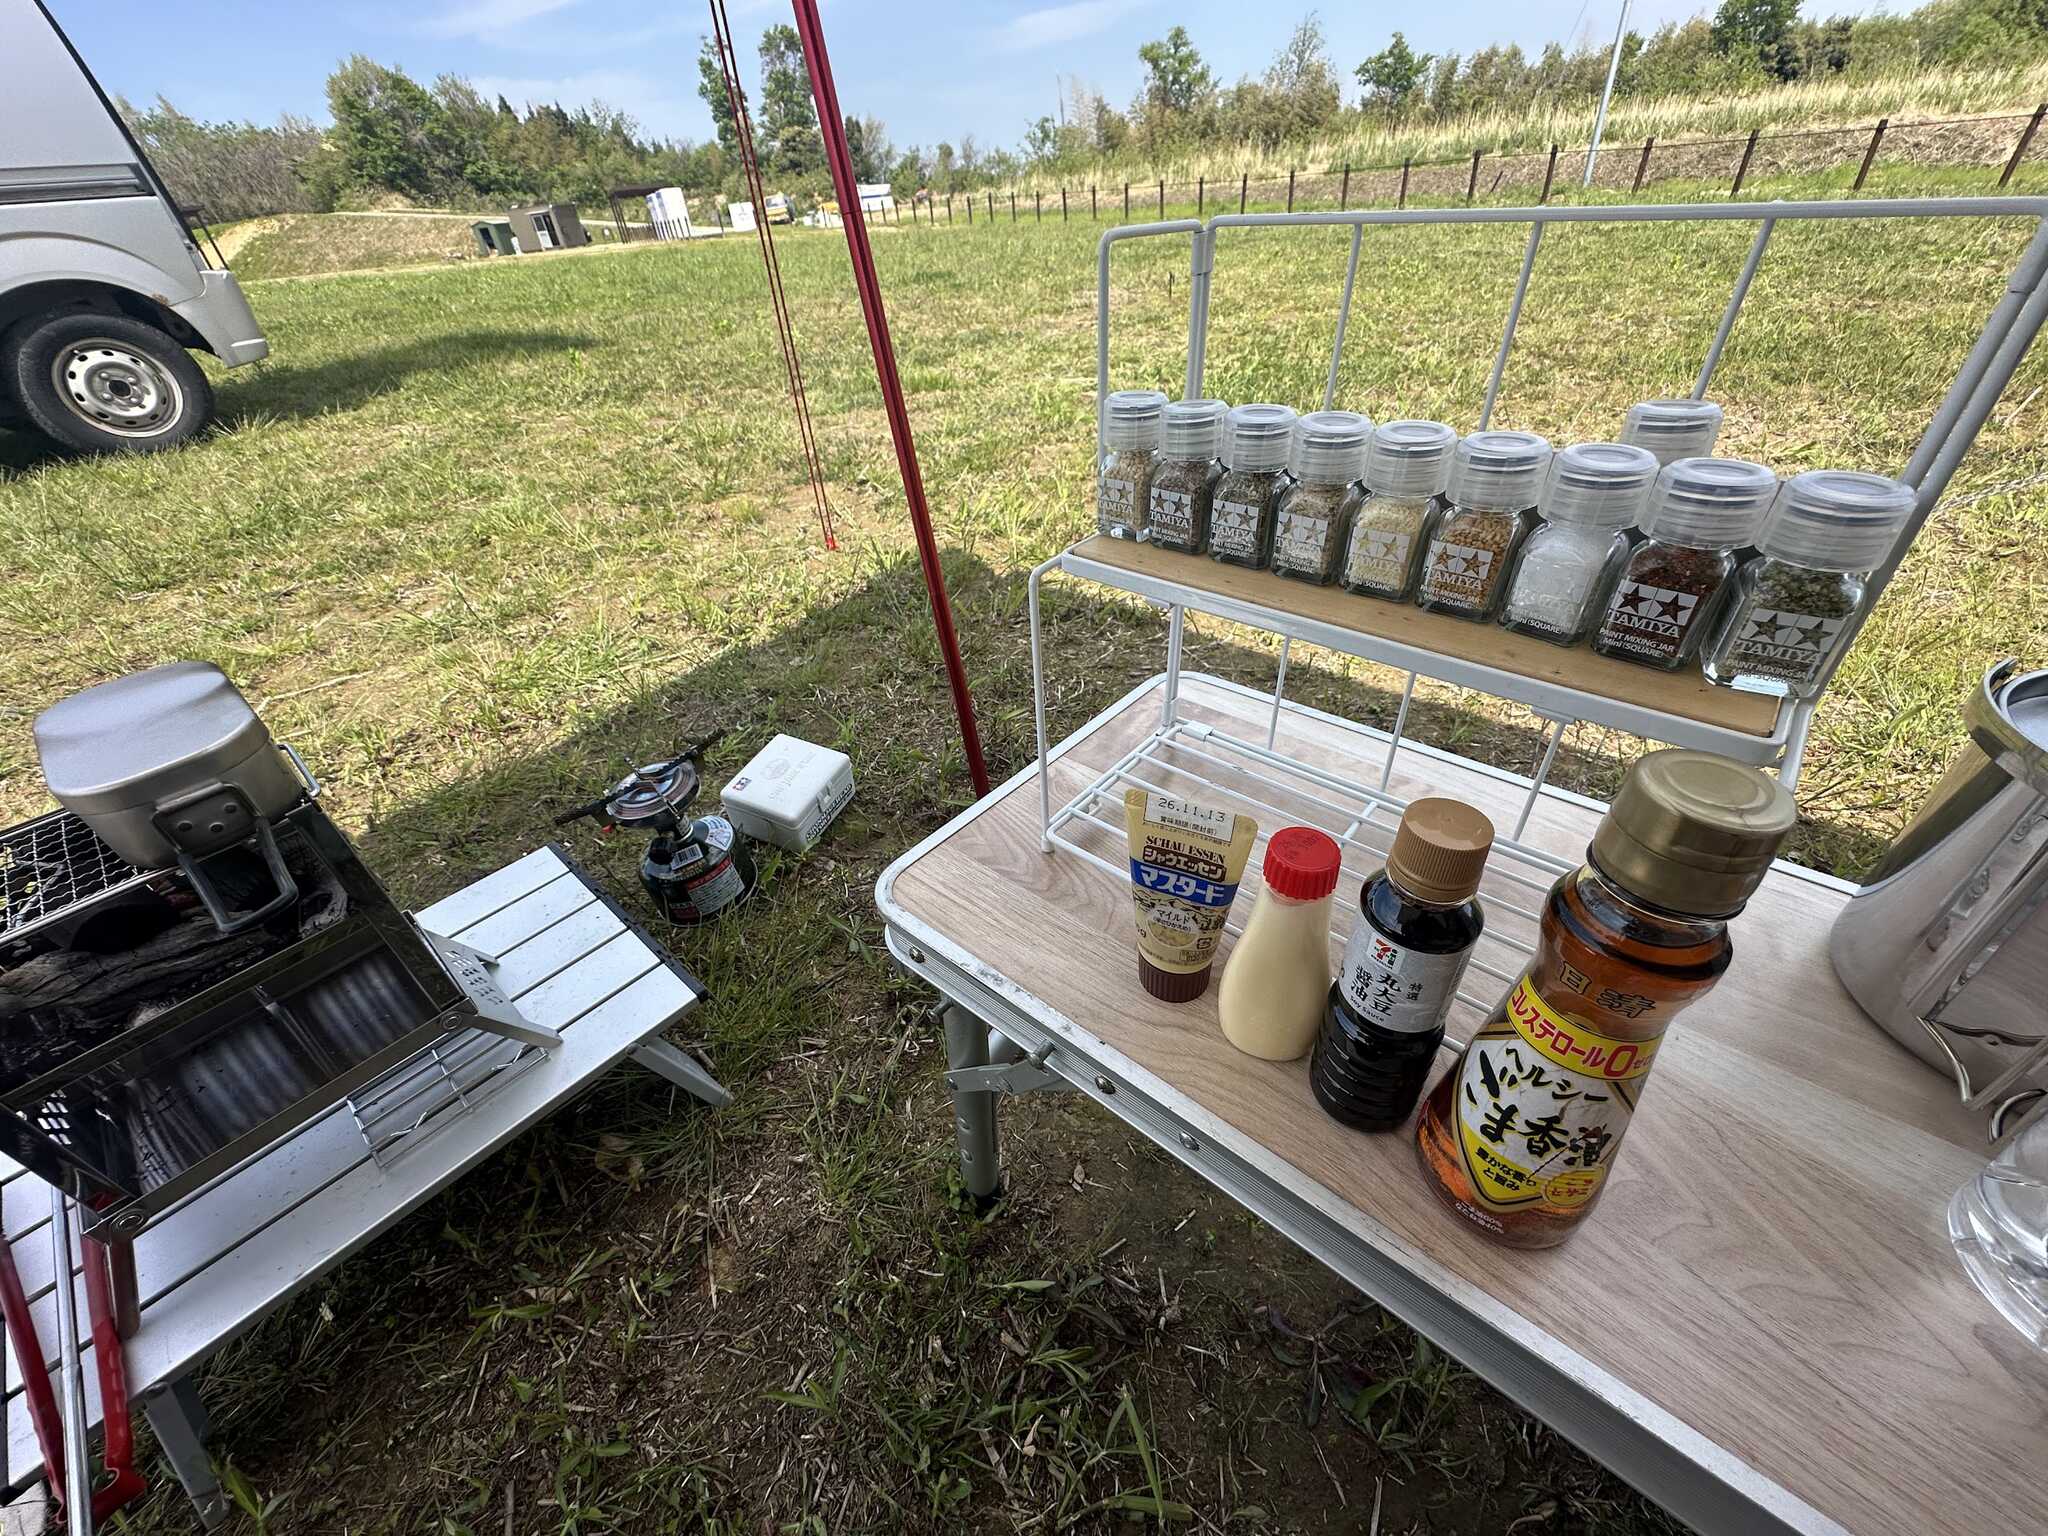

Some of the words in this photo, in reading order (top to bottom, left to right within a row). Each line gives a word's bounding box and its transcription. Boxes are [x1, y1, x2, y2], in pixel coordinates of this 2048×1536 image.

[1150, 510, 1189, 528] TAMIYA
[1211, 523, 1255, 542] TAMIYA
[1426, 566, 1483, 591] TAMIYA
[1607, 607, 1681, 639] TAMIYA
[1599, 626, 1625, 640] PAINT
[1623, 634, 1658, 649] MIXING
[1657, 643, 1676, 653] JAR
[1734, 639, 1820, 666] TAMIYA
[1752, 663, 1794, 677] MIXING
[1158, 797, 1226, 823] 26.11.13
[1144, 846, 1223, 880] シャウエッセン
[1188, 844, 1226, 865] ESSEN
[1140, 864, 1225, 904] マスタード
[1156, 909, 1191, 925] マイルド
[1369, 972, 1402, 1017] 丸大豆
[1505, 1047, 1609, 1102] ヘルシー
[1465, 1049, 1613, 1167] ごま香油
